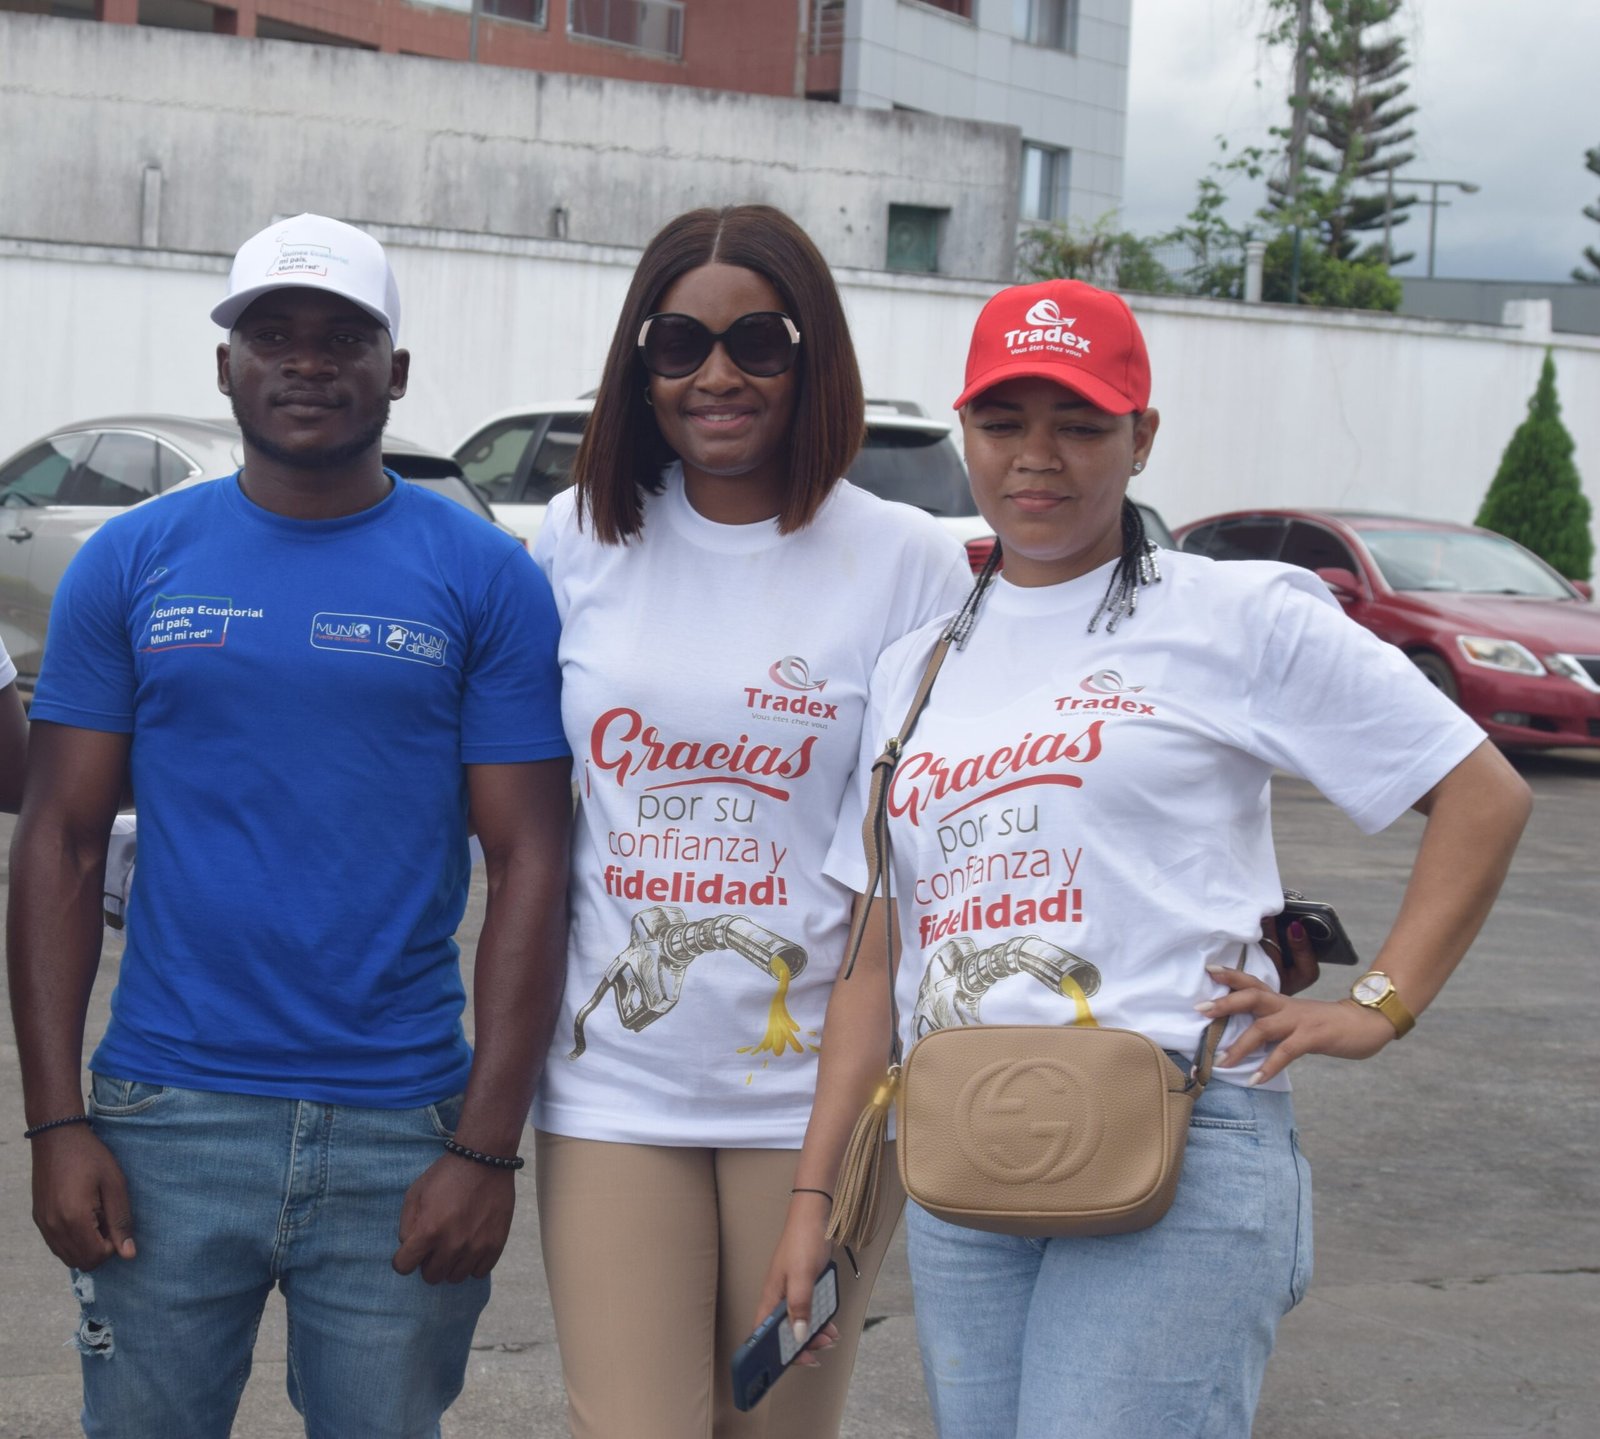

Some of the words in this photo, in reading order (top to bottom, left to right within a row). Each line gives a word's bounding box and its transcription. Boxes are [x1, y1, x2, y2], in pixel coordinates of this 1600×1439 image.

[1004, 326, 1091, 353] Tradex
[1011, 346, 1027, 355] Vous
[1046, 344, 1063, 353] chez
[1065, 349, 1082, 358] vous
[151, 620, 164, 632] mi
[166, 616, 192, 631] país,
[155, 606, 194, 619] Guinea
[198, 605, 263, 618] Ecuatorial
[151, 632, 173, 645] Muni
[174, 630, 187, 640] mi
[406, 643, 442, 659] dinero
[409, 631, 444, 650] MUNI
[744, 687, 839, 720] Tradex
[1054, 695, 1156, 716] Tradex
[752, 713, 770, 721] Vous
[792, 718, 809, 727] chez
[887, 720, 1106, 827] Gracias
[637, 794, 703, 827] por
[714, 796, 756, 823] su
[936, 813, 988, 864] por
[998, 804, 1039, 835] su
[608, 827, 759, 863] confianza
[769, 841, 787, 874] y
[1062, 848, 1083, 887] y
[604, 864, 788, 906] fidelidad!
[918, 888, 1083, 950] fidelidad!
